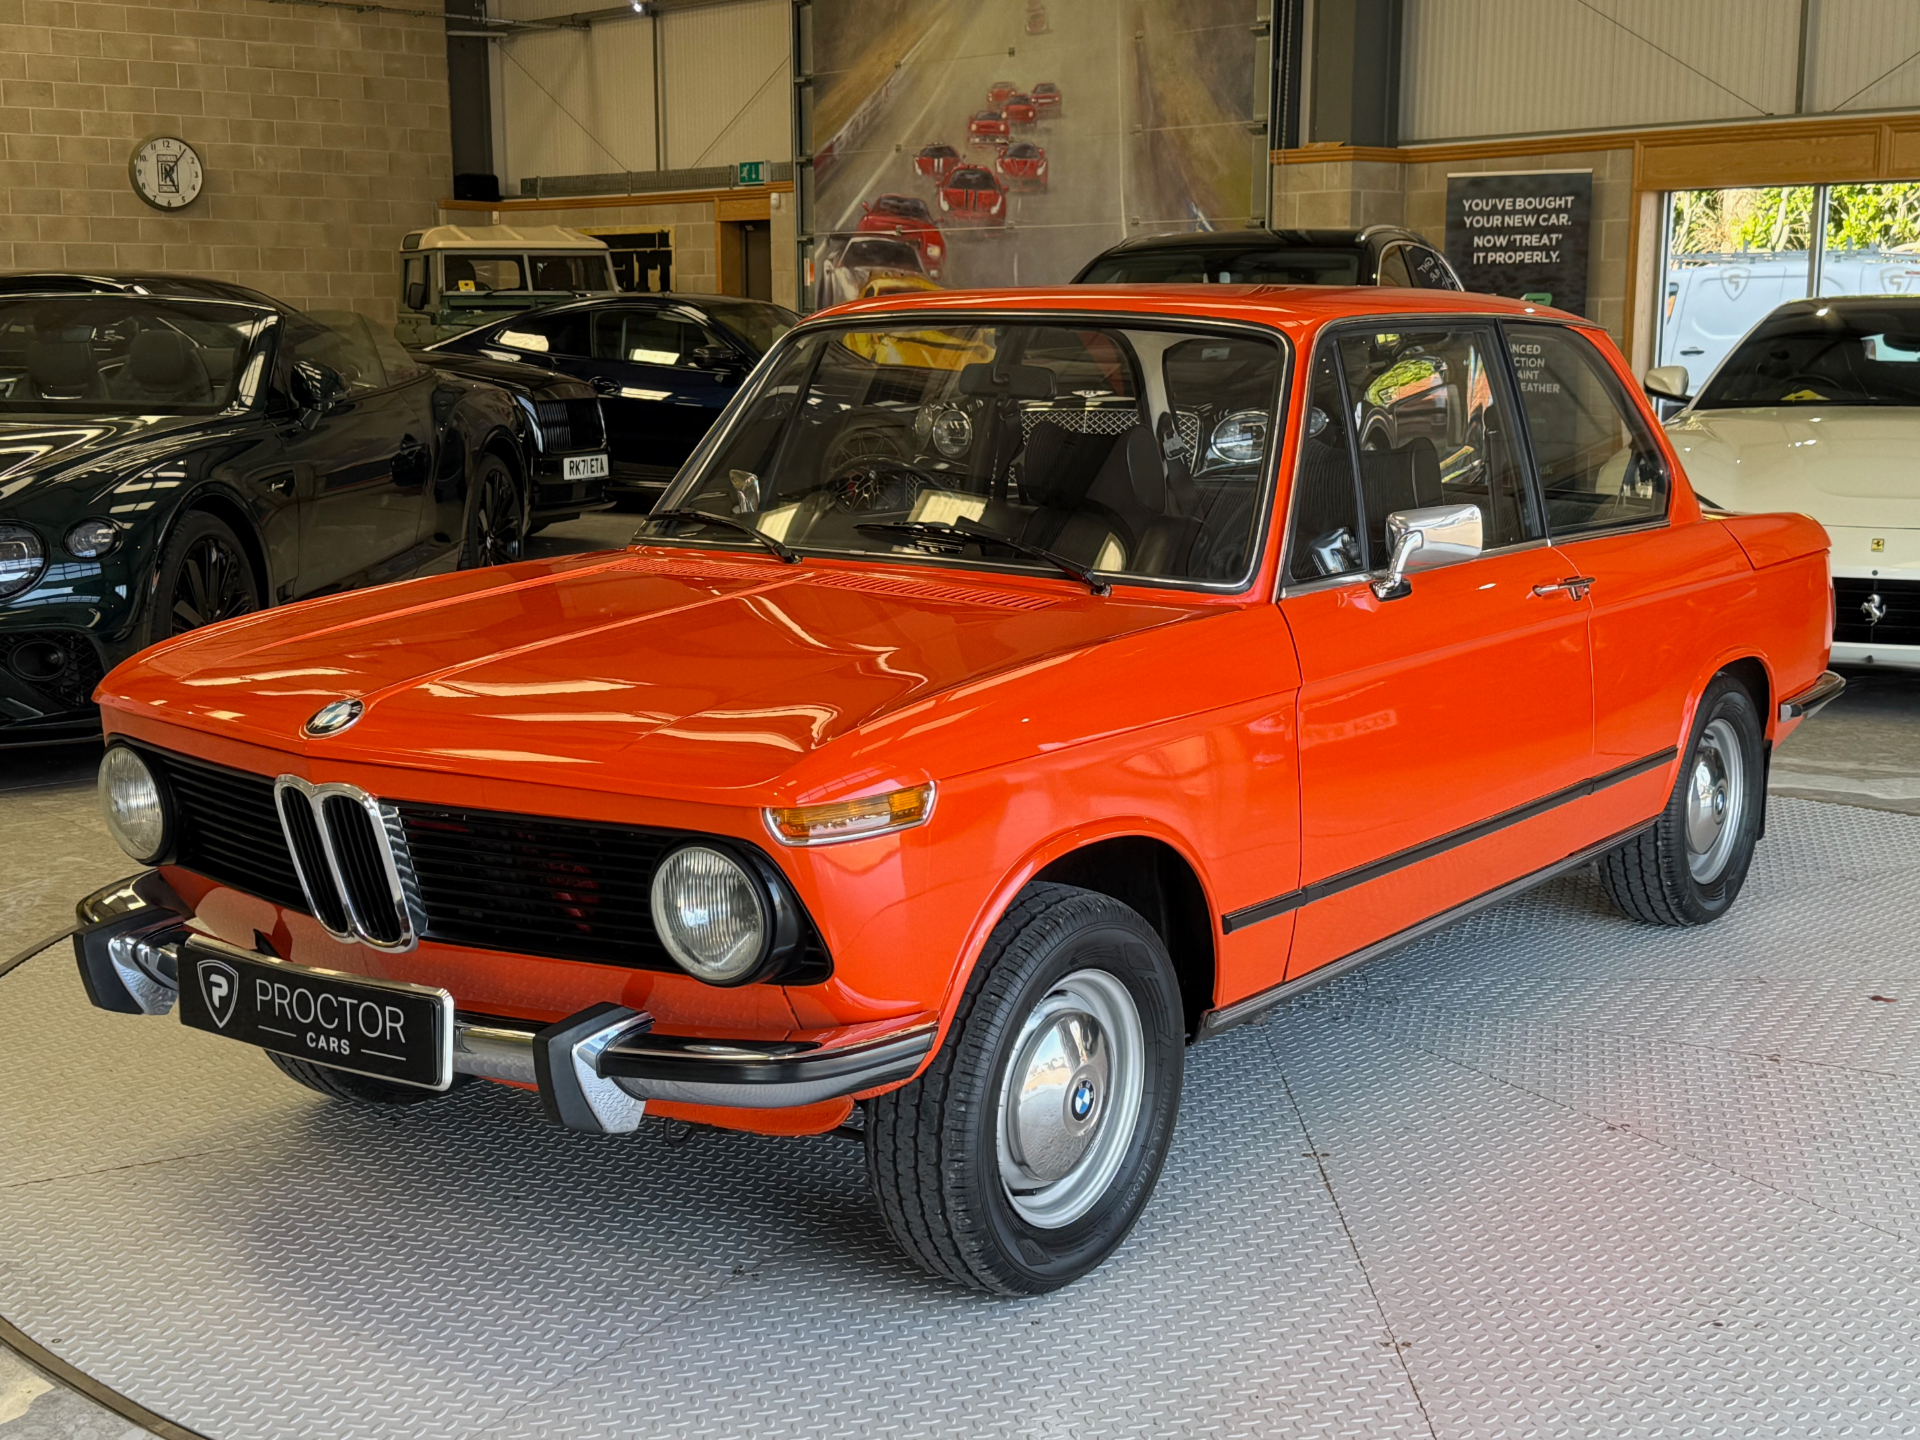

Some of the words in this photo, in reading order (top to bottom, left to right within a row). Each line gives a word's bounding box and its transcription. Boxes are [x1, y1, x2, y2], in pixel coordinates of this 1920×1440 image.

[151, 143, 156, 151] 11
[163, 140, 170, 148] 12
[190, 156, 195, 164] 2
[1516, 196, 1574, 210] BOUGHT
[1464, 216, 1502, 228] YOUR
[1504, 214, 1538, 227] NEW
[1539, 214, 1572, 226] CAR.
[1474, 235, 1509, 248] NOW
[1473, 252, 1486, 264] IT
[1488, 250, 1560, 264] PROPERLY.
[1520, 382, 1560, 394] EATHER
[256, 979, 406, 1043] PROCTOR
[306, 1032, 350, 1055] CARS
